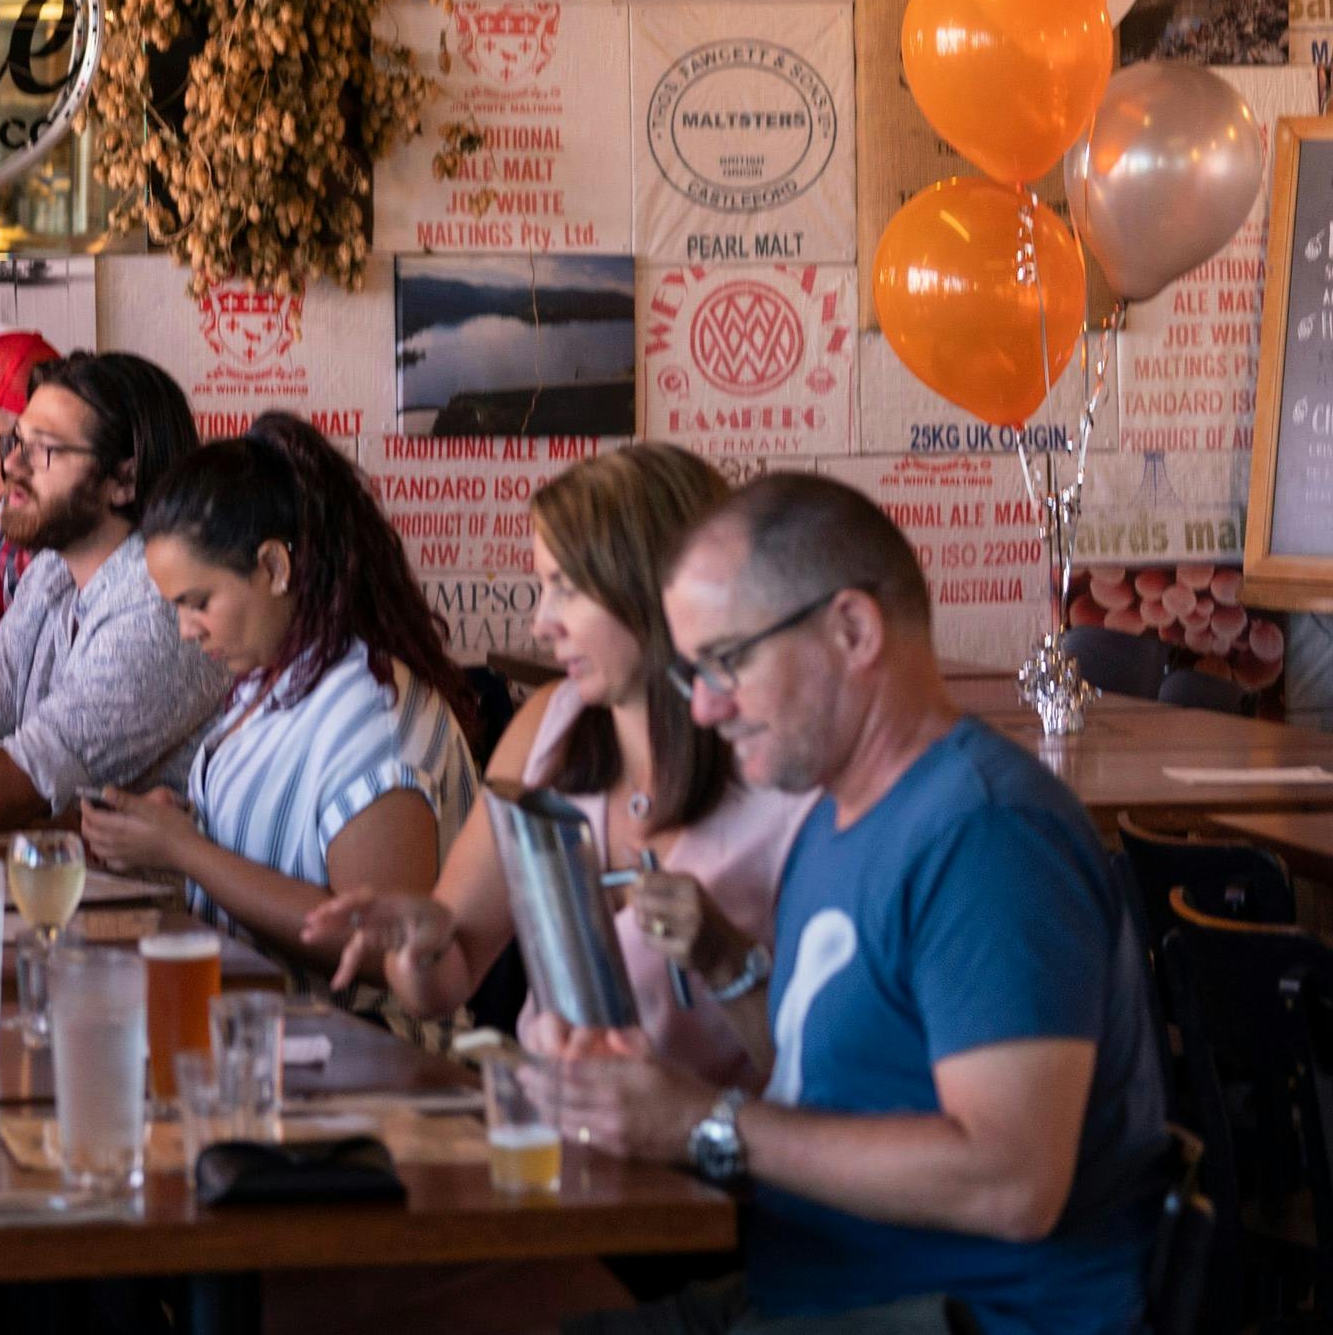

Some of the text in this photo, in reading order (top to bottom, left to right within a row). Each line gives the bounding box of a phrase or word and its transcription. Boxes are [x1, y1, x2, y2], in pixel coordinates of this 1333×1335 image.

[683, 112, 806, 129] MALTSTERS
[457, 158, 555, 182] ALE MALT
[498, 192, 564, 216] WHITE
[417, 223, 512, 248] MALTINGS
[565, 222, 599, 246] Ltd.
[687, 232, 804, 260] PEARL MALT
[1135, 355, 1228, 380] MALTINGS
[312, 411, 363, 435] MALT
[384, 436, 538, 461] TRADITIONAL ALE
[548, 436, 599, 463] MALT
[911, 425, 959, 450] 25KG
[965, 425, 993, 450] UK
[1121, 428, 1226, 453] PRODUCT OF
[371, 477, 530, 501] STANDARD ISO
[392, 513, 488, 538] PRODUCT OF
[941, 543, 1041, 565] ISO 22000
[940, 578, 1023, 604] AUSTRALIA
